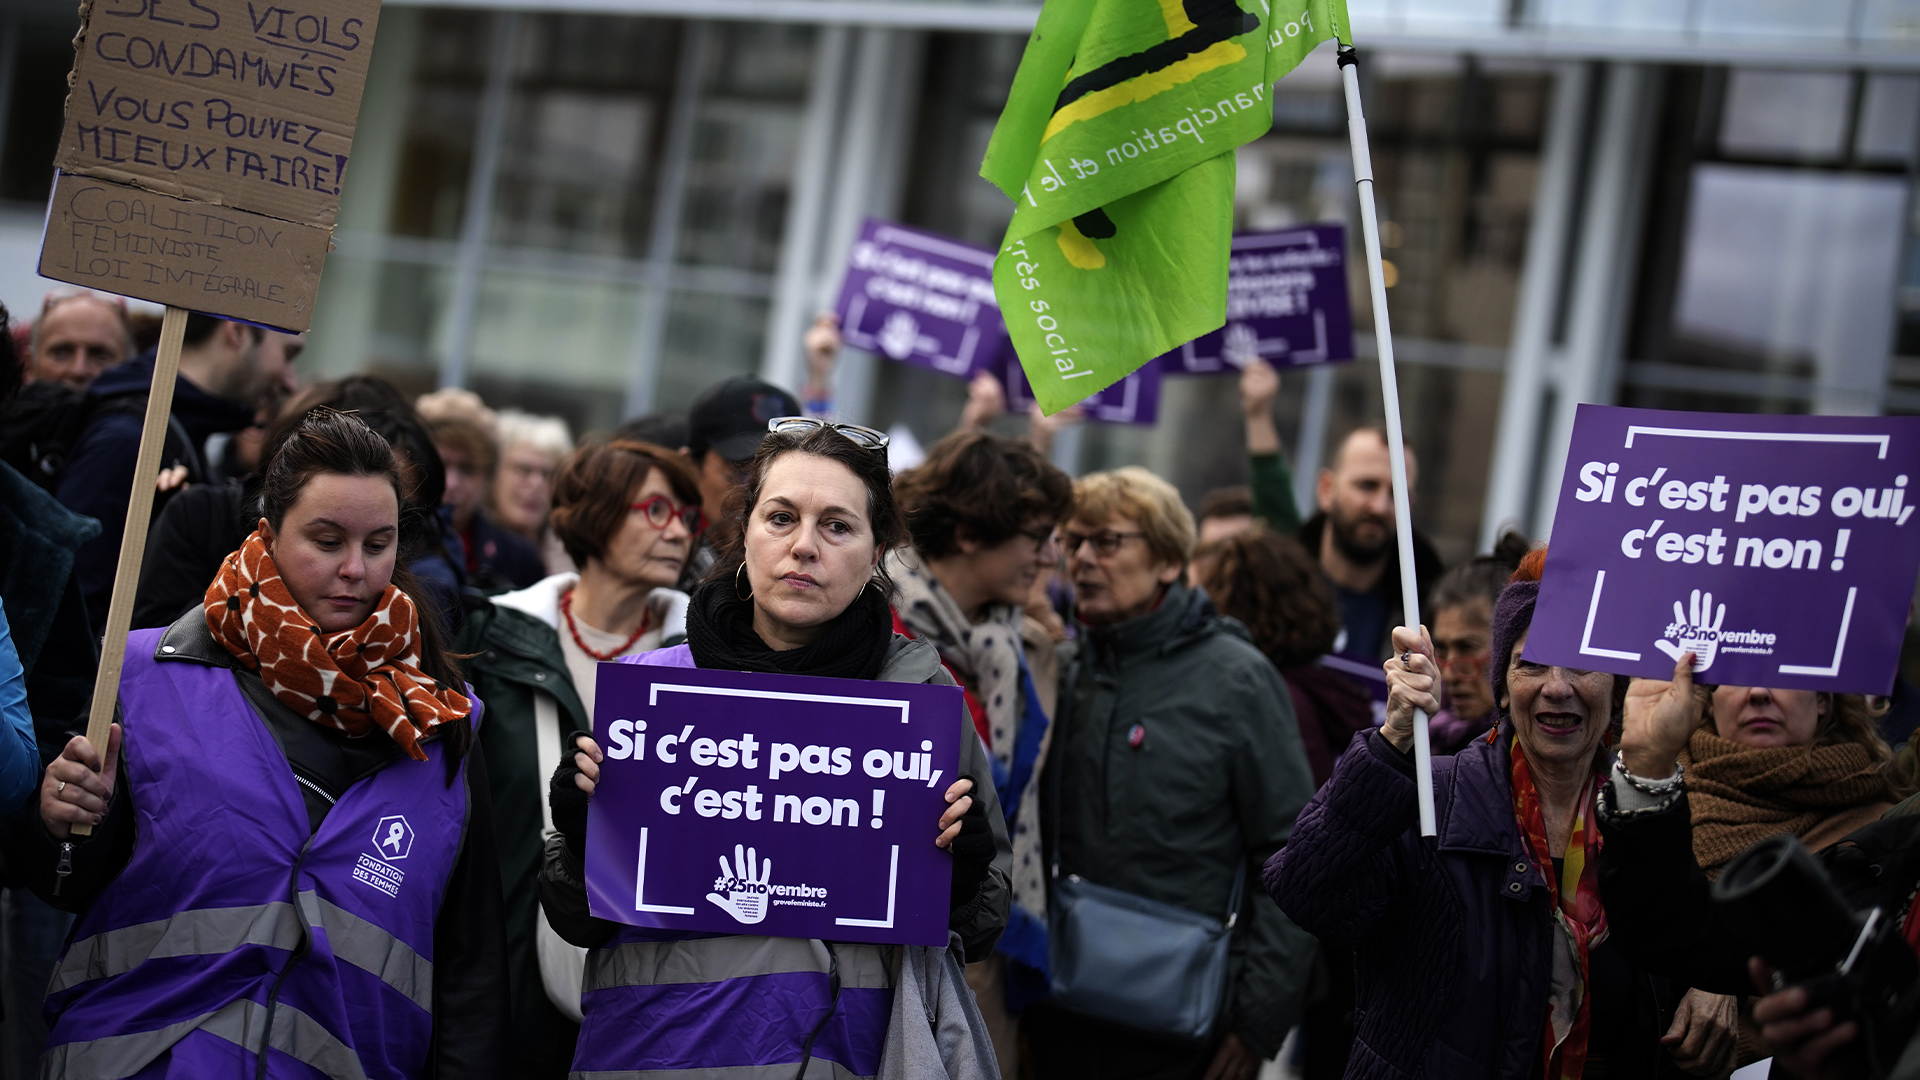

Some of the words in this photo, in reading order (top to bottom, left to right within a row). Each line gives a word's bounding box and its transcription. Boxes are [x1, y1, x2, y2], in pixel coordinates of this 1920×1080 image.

[247, 2, 363, 51] VIOLS
[96, 32, 337, 97] CONDAMNÉS
[88, 80, 194, 129] VOUS
[204, 98, 332, 157] POUVEZ
[77, 121, 217, 171] MIEUX
[226, 147, 348, 195] FAIRE!
[71, 187, 282, 247] COALITION
[72, 221, 222, 262] FEMINISTE
[142, 265, 285, 303] INTÉGRALE
[1029, 300, 1094, 380] social
[1575, 461, 1620, 503] Si
[1624, 467, 1730, 512] c'est
[1735, 483, 1822, 522] pas
[1831, 474, 1915, 526] oui,
[1620, 519, 1727, 565] c'est
[1733, 535, 1822, 571] non
[1830, 529, 1851, 572] !
[1664, 622, 1777, 645] #25novembre
[607, 719, 648, 760] Si
[656, 724, 759, 769] c'est
[768, 741, 852, 780] pas
[862, 740, 944, 788] oui,
[660, 776, 763, 821] c'est
[773, 794, 859, 828] non
[870, 789, 886, 829] !
[352, 867, 369, 880] DES
[370, 875, 399, 895] FEMMES
[357, 855, 404, 884] FONDATION
[714, 876, 828, 898] #25novembre
[772, 899, 827, 908] grevefeministe.fr
